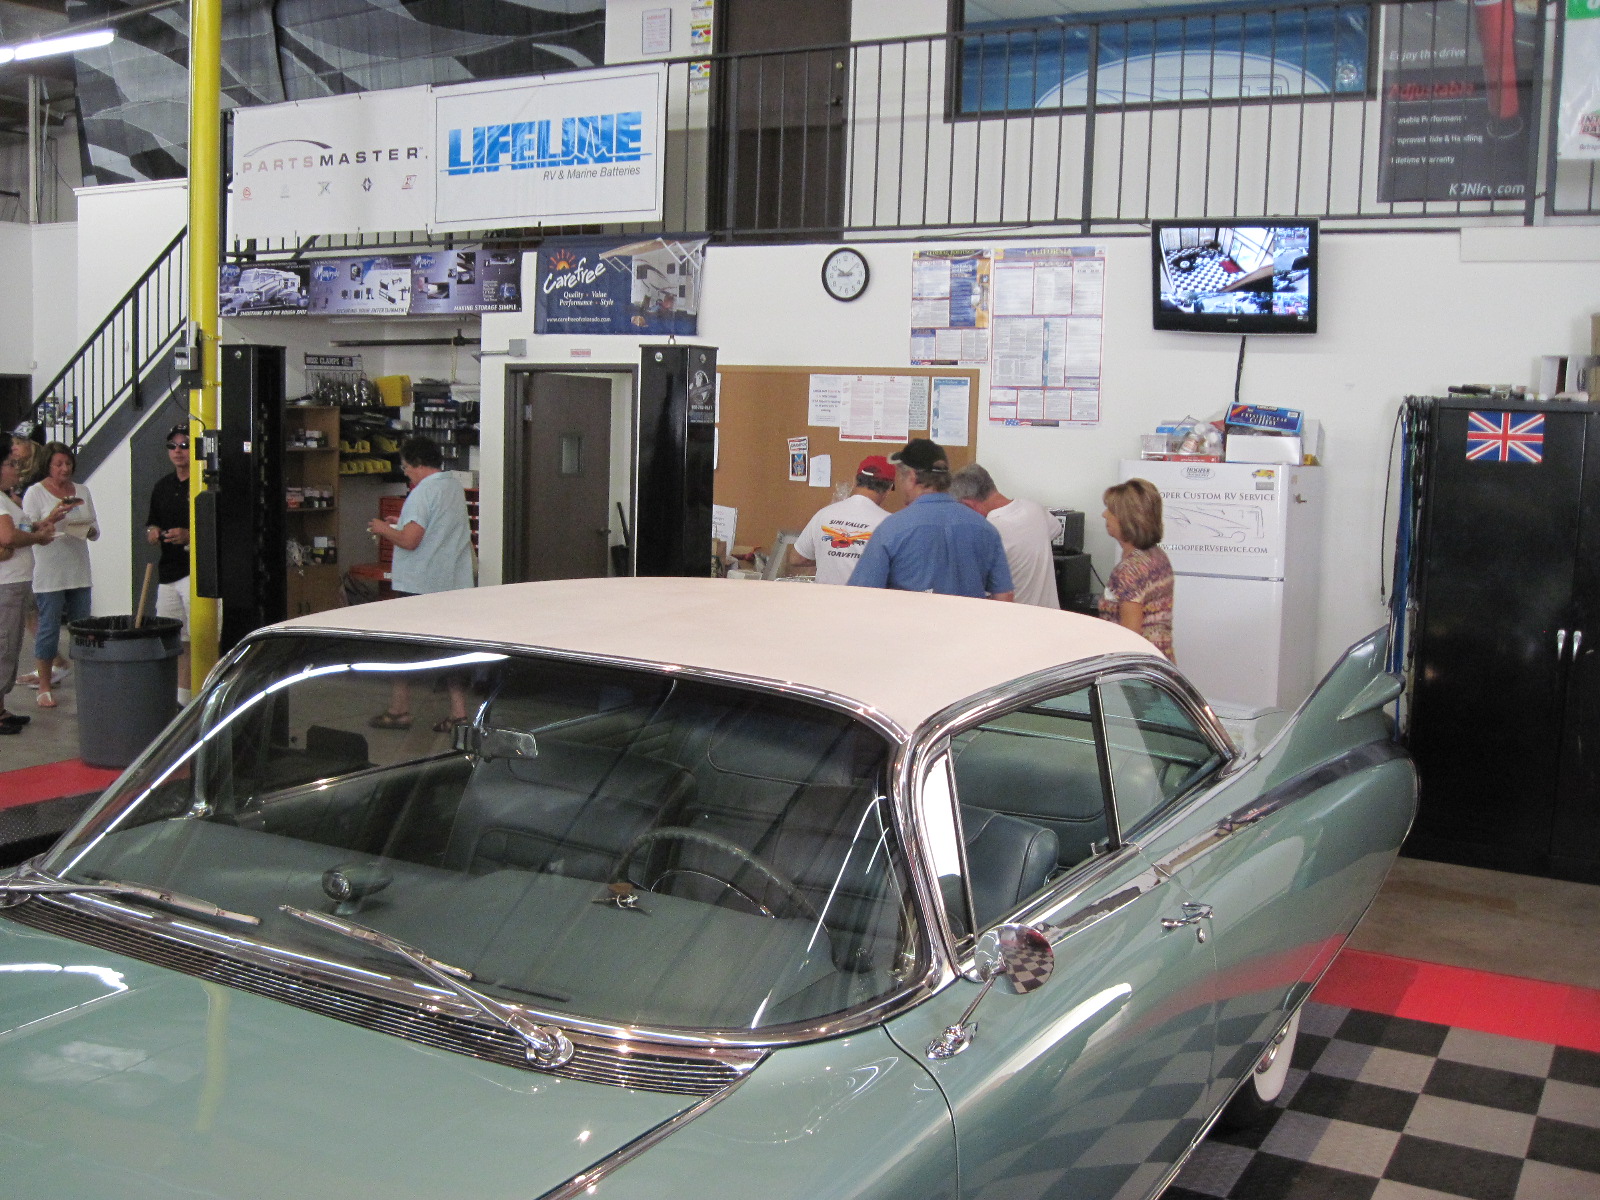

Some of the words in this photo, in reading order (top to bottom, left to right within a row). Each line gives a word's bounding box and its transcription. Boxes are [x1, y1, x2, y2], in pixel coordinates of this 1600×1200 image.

[448, 111, 642, 176] LIFELINE
[242, 147, 419, 174] PARTSMASTER
[543, 170, 555, 181] RV
[558, 169, 565, 180] &
[567, 168, 598, 179] Marine
[599, 166, 641, 177] Batteries
[543, 257, 606, 294] Carefree
[563, 291, 584, 299] Quality
[1224, 492, 1237, 500] RV
